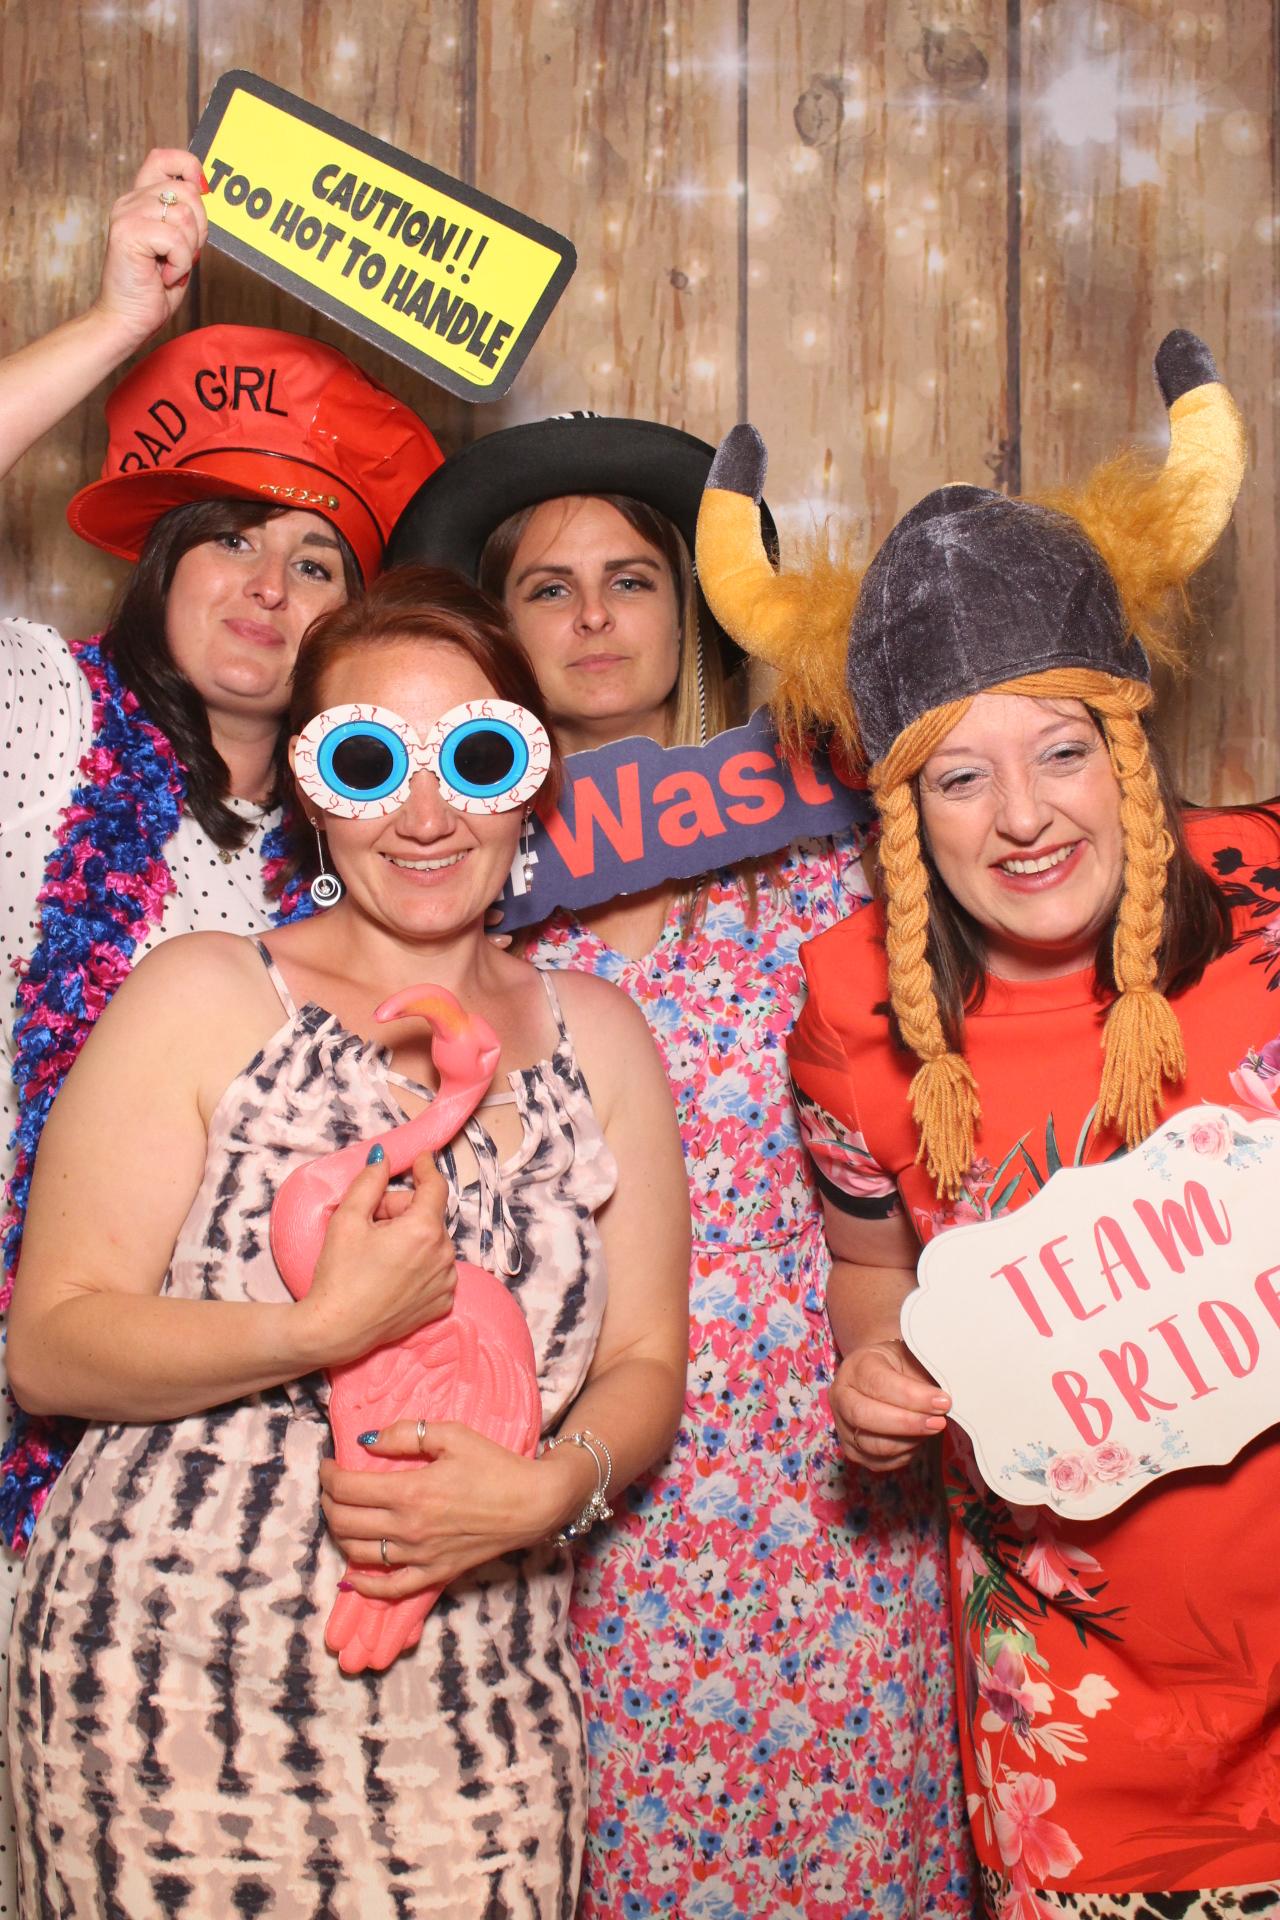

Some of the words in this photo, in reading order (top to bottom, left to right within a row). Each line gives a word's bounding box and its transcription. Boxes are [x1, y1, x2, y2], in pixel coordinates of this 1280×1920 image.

[207, 158, 273, 220] TOO
[269, 198, 346, 263] HOT
[340, 237, 387, 290] TO
[381, 263, 515, 370] HANDLE
[311, 163, 489, 284] CAUTION!!
[195, 365, 288, 417] GIRL
[990, 1180, 1232, 1338] TEAM
